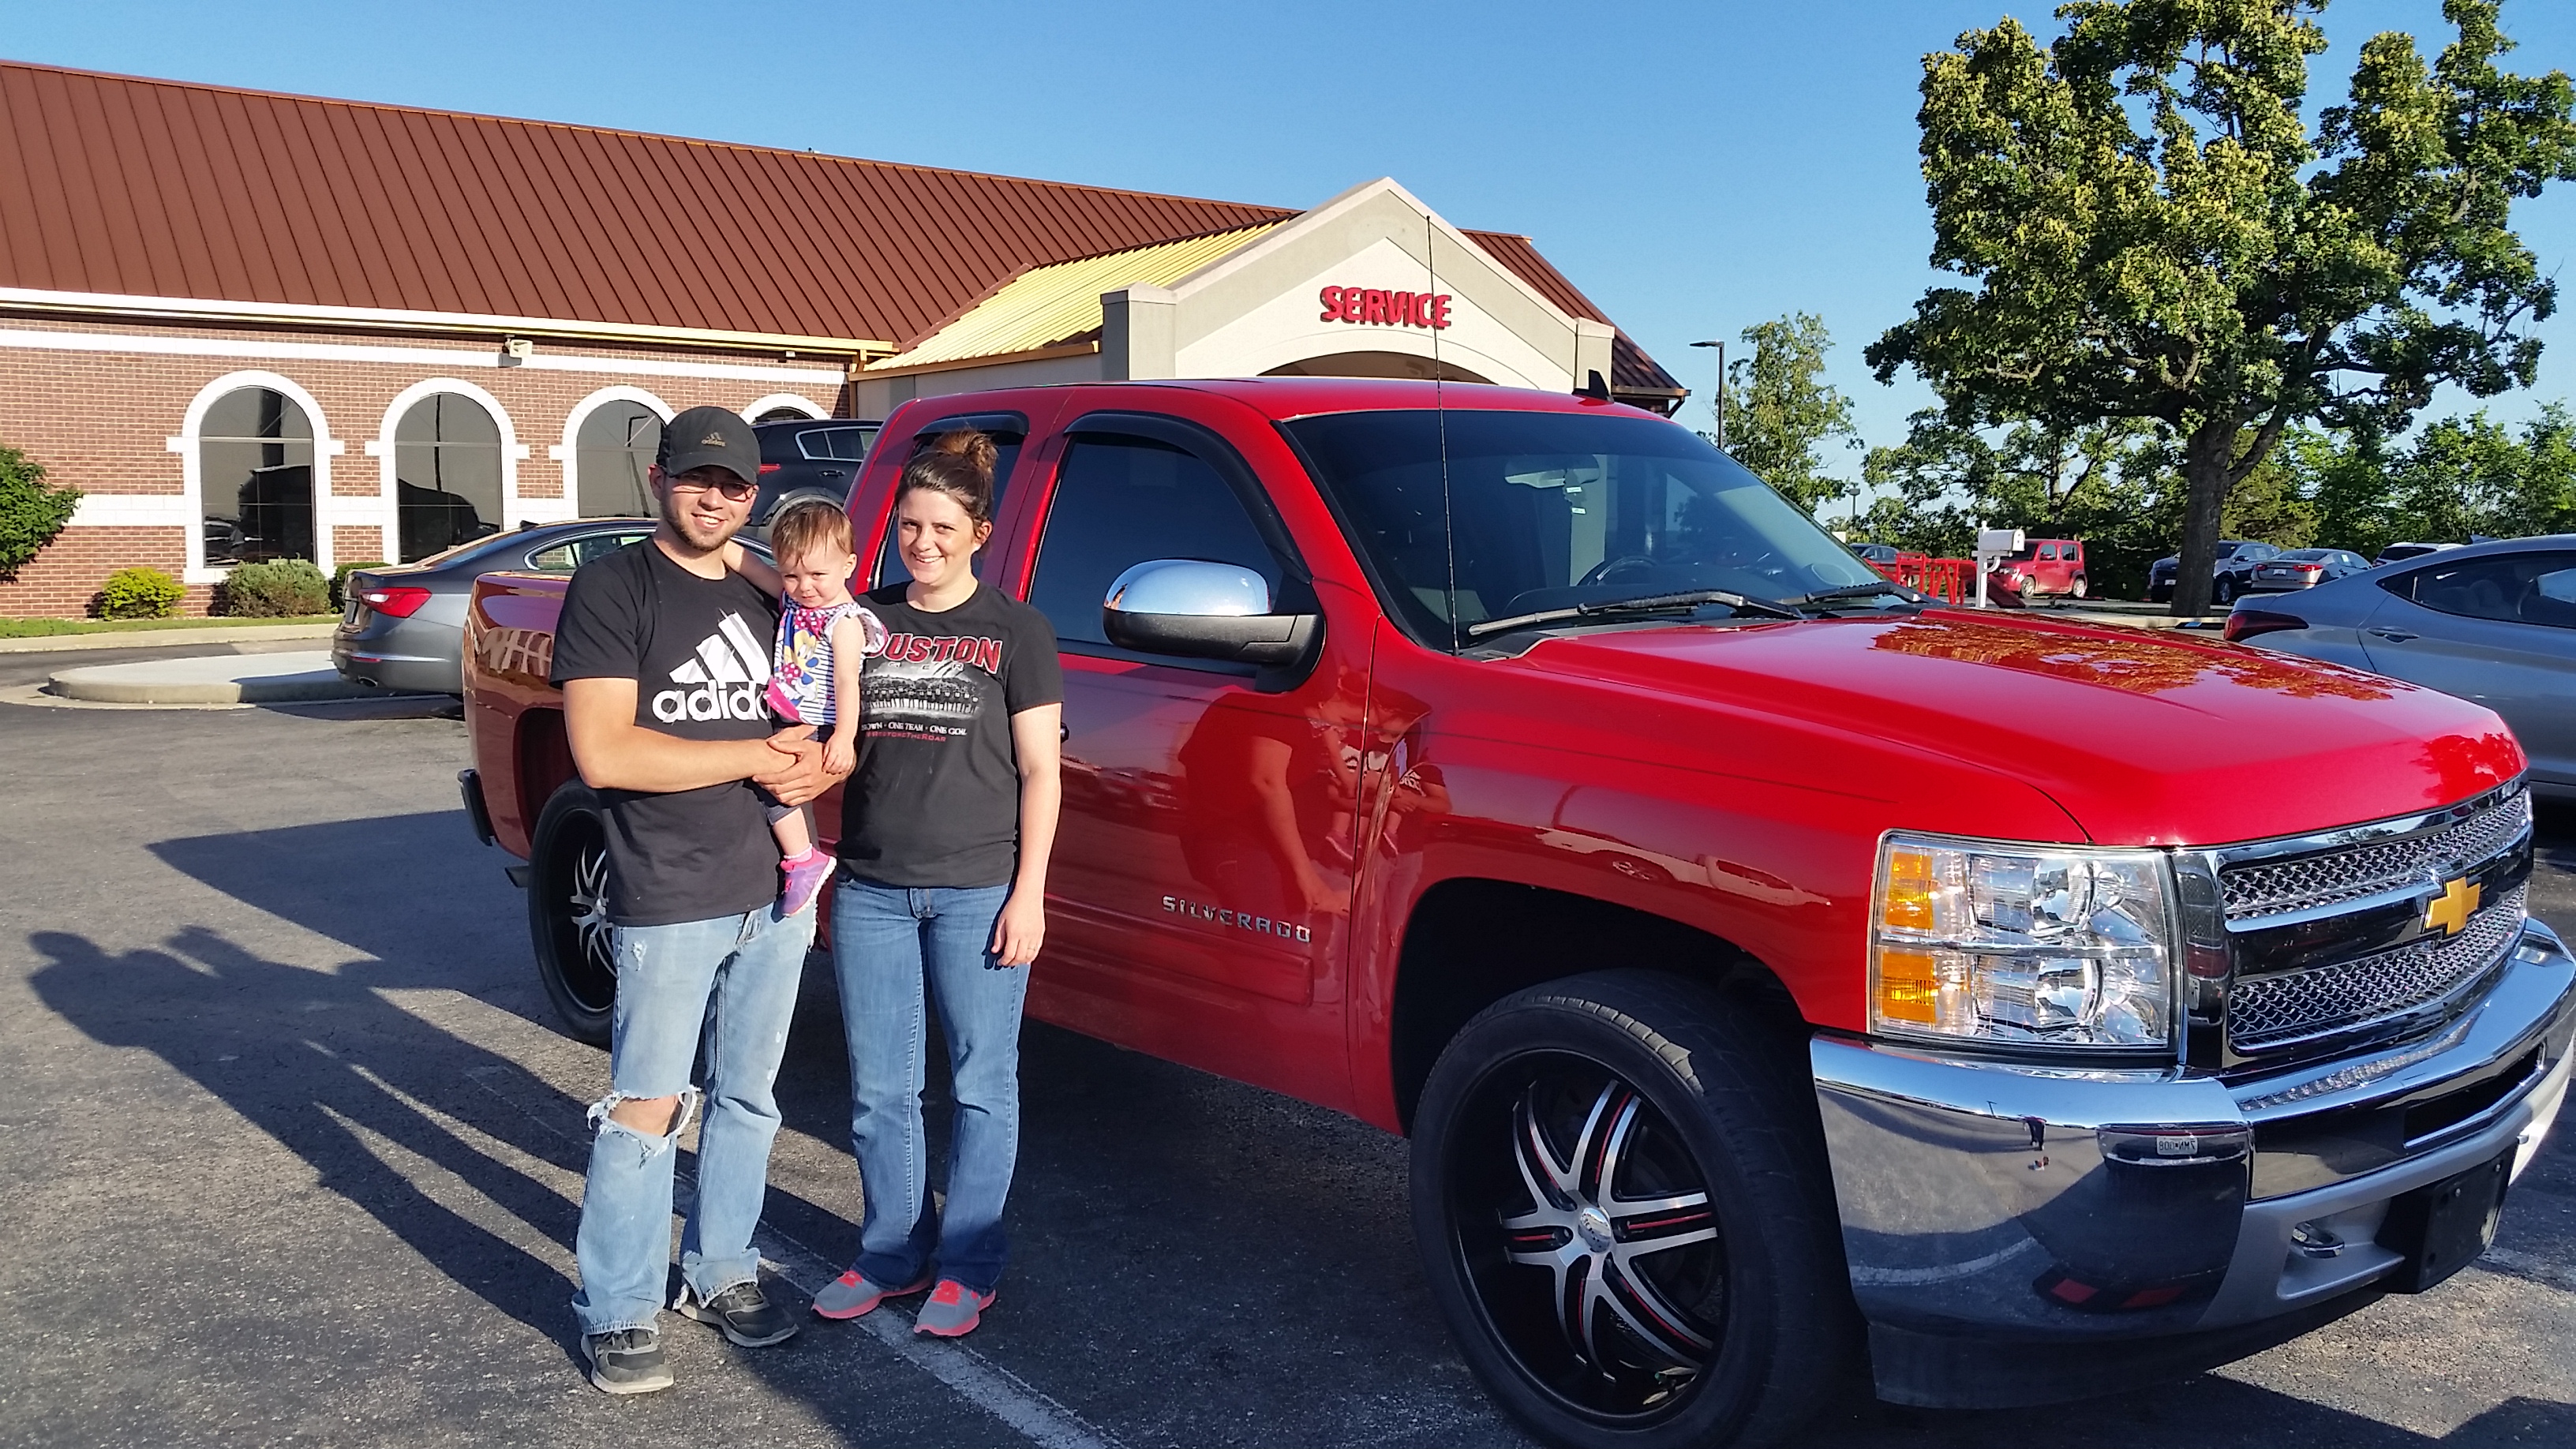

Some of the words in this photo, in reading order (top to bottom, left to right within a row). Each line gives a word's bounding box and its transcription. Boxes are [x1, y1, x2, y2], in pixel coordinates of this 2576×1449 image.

[1320, 286, 1451, 330] SERVICE
[867, 634, 1002, 675] USTON
[652, 679, 770, 724] adid
[888, 721, 904, 730] ONE
[930, 724, 947, 734] ONE
[1163, 895, 1312, 943] SILVERADO
